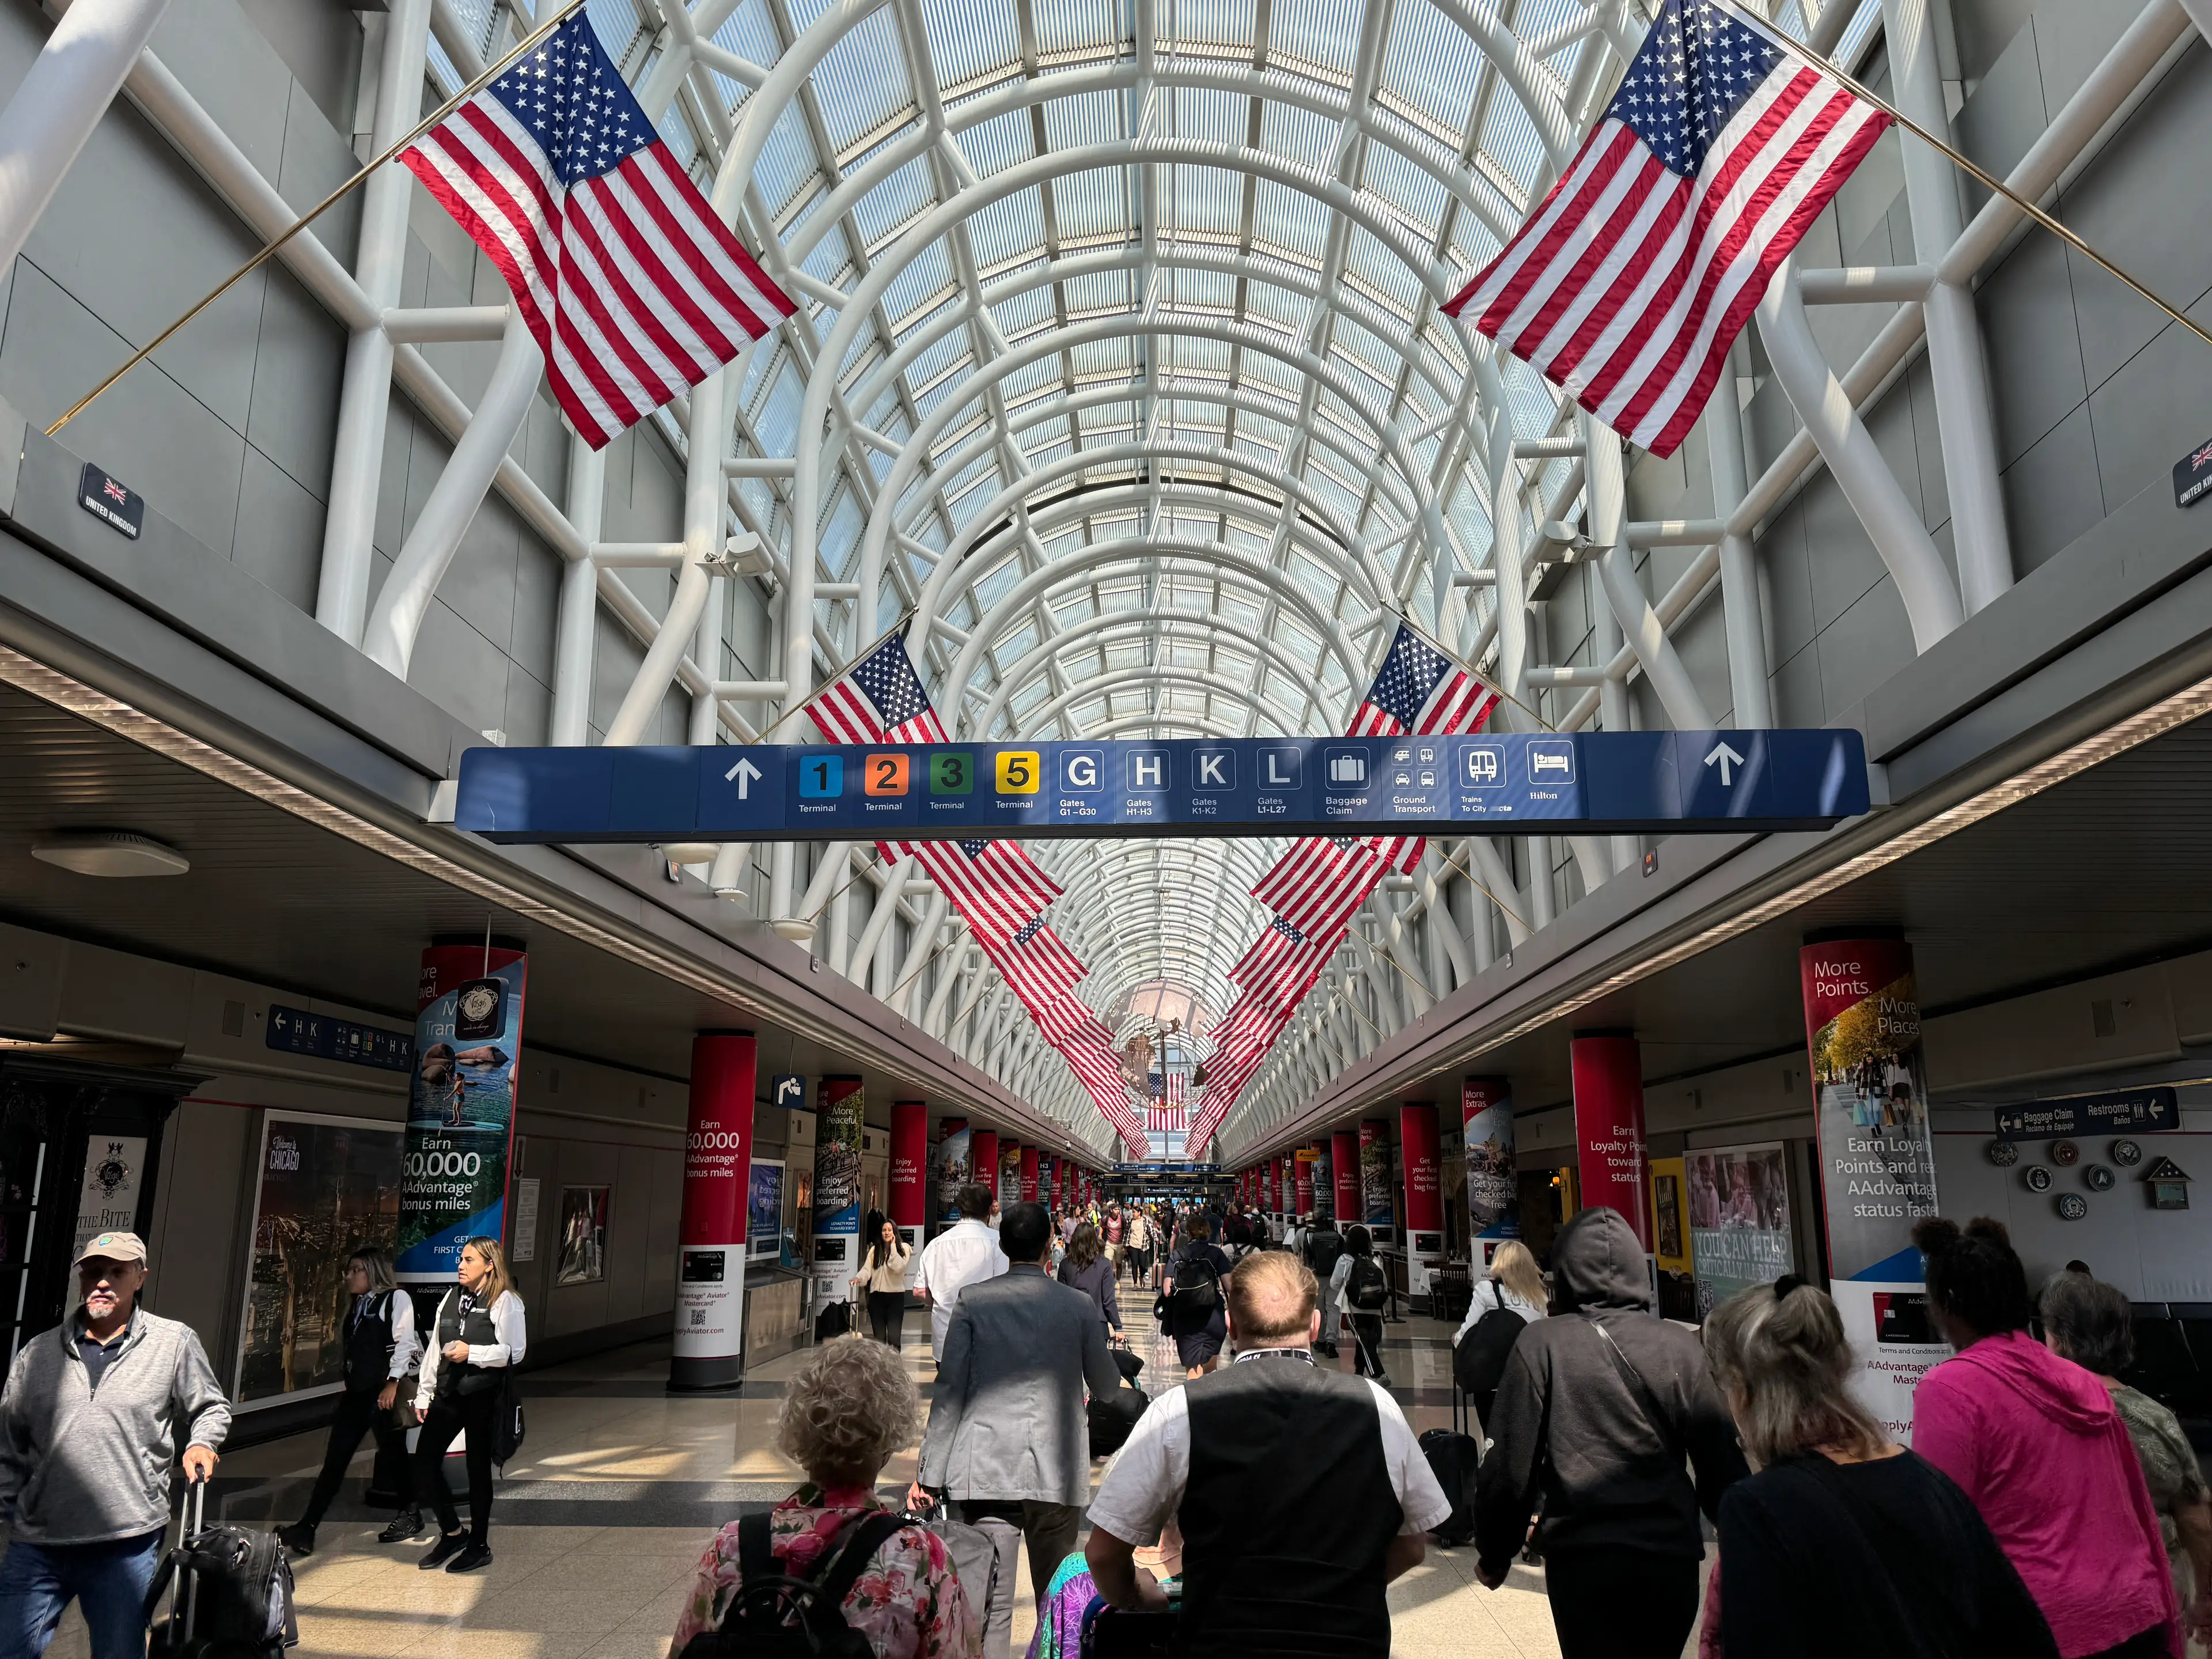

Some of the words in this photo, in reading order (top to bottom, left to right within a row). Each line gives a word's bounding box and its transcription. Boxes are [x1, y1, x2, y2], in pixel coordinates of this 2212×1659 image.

[2180, 482, 2202, 503] UNITED
[86, 496, 108, 517] UNITED
[108, 511, 137, 536] KINGDOM
[813, 762, 827, 790] 1
[876, 760, 897, 789] 2
[941, 759, 963, 787] 3
[1006, 757, 1029, 787] 5
[1068, 756, 1095, 786] G
[1137, 756, 1160, 785] H
[1201, 755, 1226, 784] K
[1268, 755, 1290, 783] L
[865, 802, 902, 810] Terminal
[1326, 797, 1368, 806] Baggage
[799, 804, 836, 812] Terminal
[1393, 805, 1435, 813] Transport
[421, 967, 437, 979] ore
[1815, 961, 1861, 978] More
[1816, 979, 1872, 998] Points.
[469, 995, 487, 1010] Vosges
[1880, 997, 1916, 1014] More
[295, 1019, 302, 1035] H
[310, 1022, 317, 1037] K
[389, 1039, 396, 1052] H
[402, 1041, 407, 1055] K
[1465, 1090, 1484, 1099] More
[1465, 1099, 1487, 1108] Extras.
[2088, 1103, 2130, 1116] Restrooms
[833, 1107, 853, 1115] More
[2024, 1109, 2053, 1124] Baggage
[2054, 1109, 2074, 1120] Claim
[700, 1120, 721, 1129] Earn
[2113, 1115, 2131, 1125] Baños
[1613, 1125, 1635, 1136] Earn
[2025, 1124, 2045, 1133] Reclamo
[2054, 1122, 2074, 1132] Equipaje
[422, 1137, 451, 1150] Earn
[687, 1132, 740, 1151] 60,000
[1590, 1141, 1627, 1154] Loyalty
[1629, 1141, 1647, 1152] Point
[1848, 1138, 1885, 1152] Earn
[270, 1150, 300, 1171] CHICAGO
[403, 1152, 480, 1180] 60,000
[896, 1158, 911, 1166] Enjoy
[1607, 1157, 1642, 1166] toward
[1836, 1158, 1884, 1173] Points
[1888, 1158, 1916, 1173] and
[104, 1165, 120, 1183] Vosges
[687, 1168, 708, 1177] bonus
[710, 1167, 733, 1177] miles
[892, 1166, 916, 1175] preferred
[1412, 1166, 1426, 1175] your
[822, 1176, 842, 1187] Enjoy
[892, 1175, 916, 1184] boarding
[1474, 1179, 1486, 1188] Get
[1487, 1180, 1506, 1191] your
[1507, 1179, 1517, 1188] firs
[817, 1186, 849, 1196] preferred
[1414, 1184, 1425, 1192] bag
[1475, 1188, 1506, 1199] checked
[402, 1199, 431, 1210] bonus
[435, 1196, 471, 1210] miles
[817, 1196, 847, 1207] boarding
[1491, 1200, 1507, 1210] free
[1854, 1203, 1903, 1217] status
[78, 1215, 98, 1228] THE
[100, 1209, 130, 1227] BITE
[434, 1246, 455, 1254] FIRST
[1695, 1232, 1720, 1257] YOU
[1722, 1233, 1751, 1260] CAN
[1697, 1257, 1742, 1279] CRITICALLY
